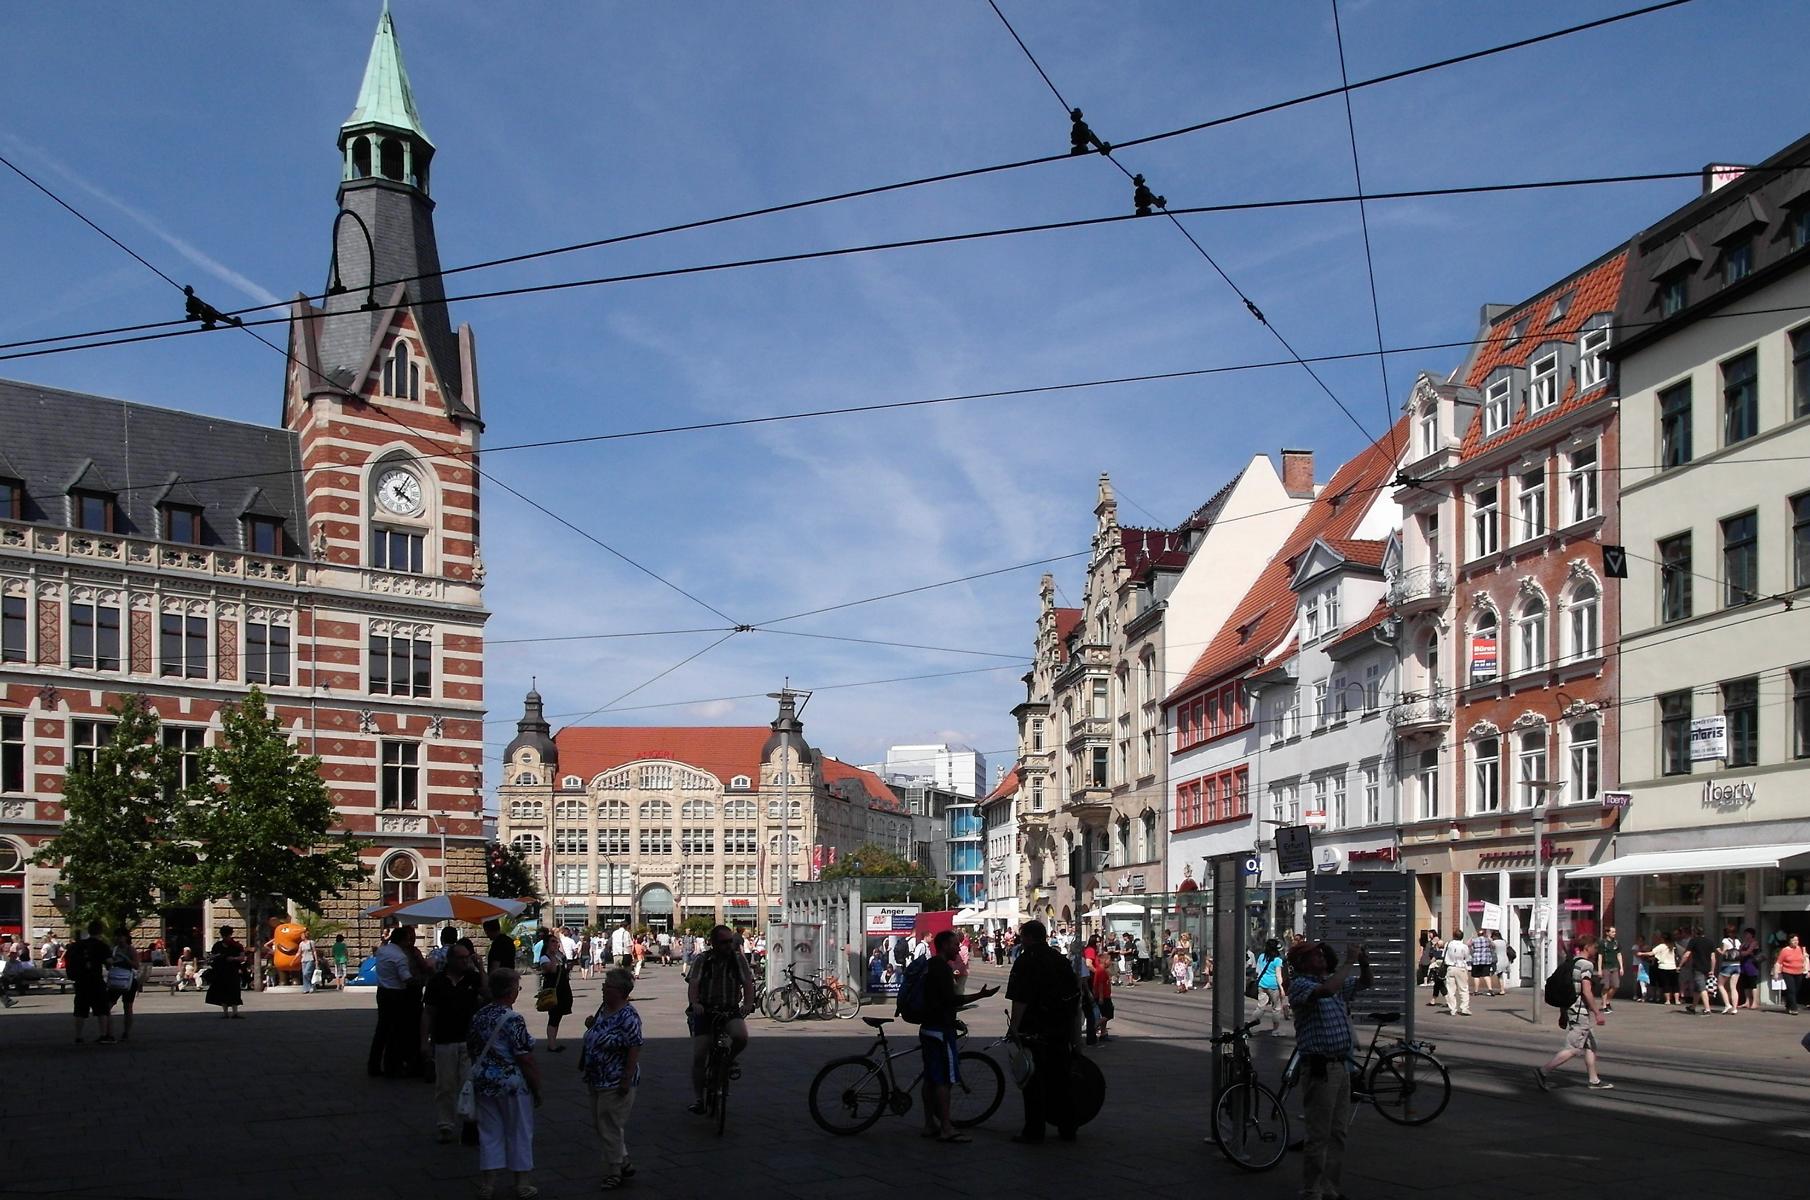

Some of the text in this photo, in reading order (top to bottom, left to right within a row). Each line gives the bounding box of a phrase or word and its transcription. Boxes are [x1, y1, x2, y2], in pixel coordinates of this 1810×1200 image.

[1702, 779, 1757, 802] liberty
[1606, 795, 1628, 806] liberty
[1283, 841, 1304, 850] Erfurt
[880, 908, 905, 918] Anger
